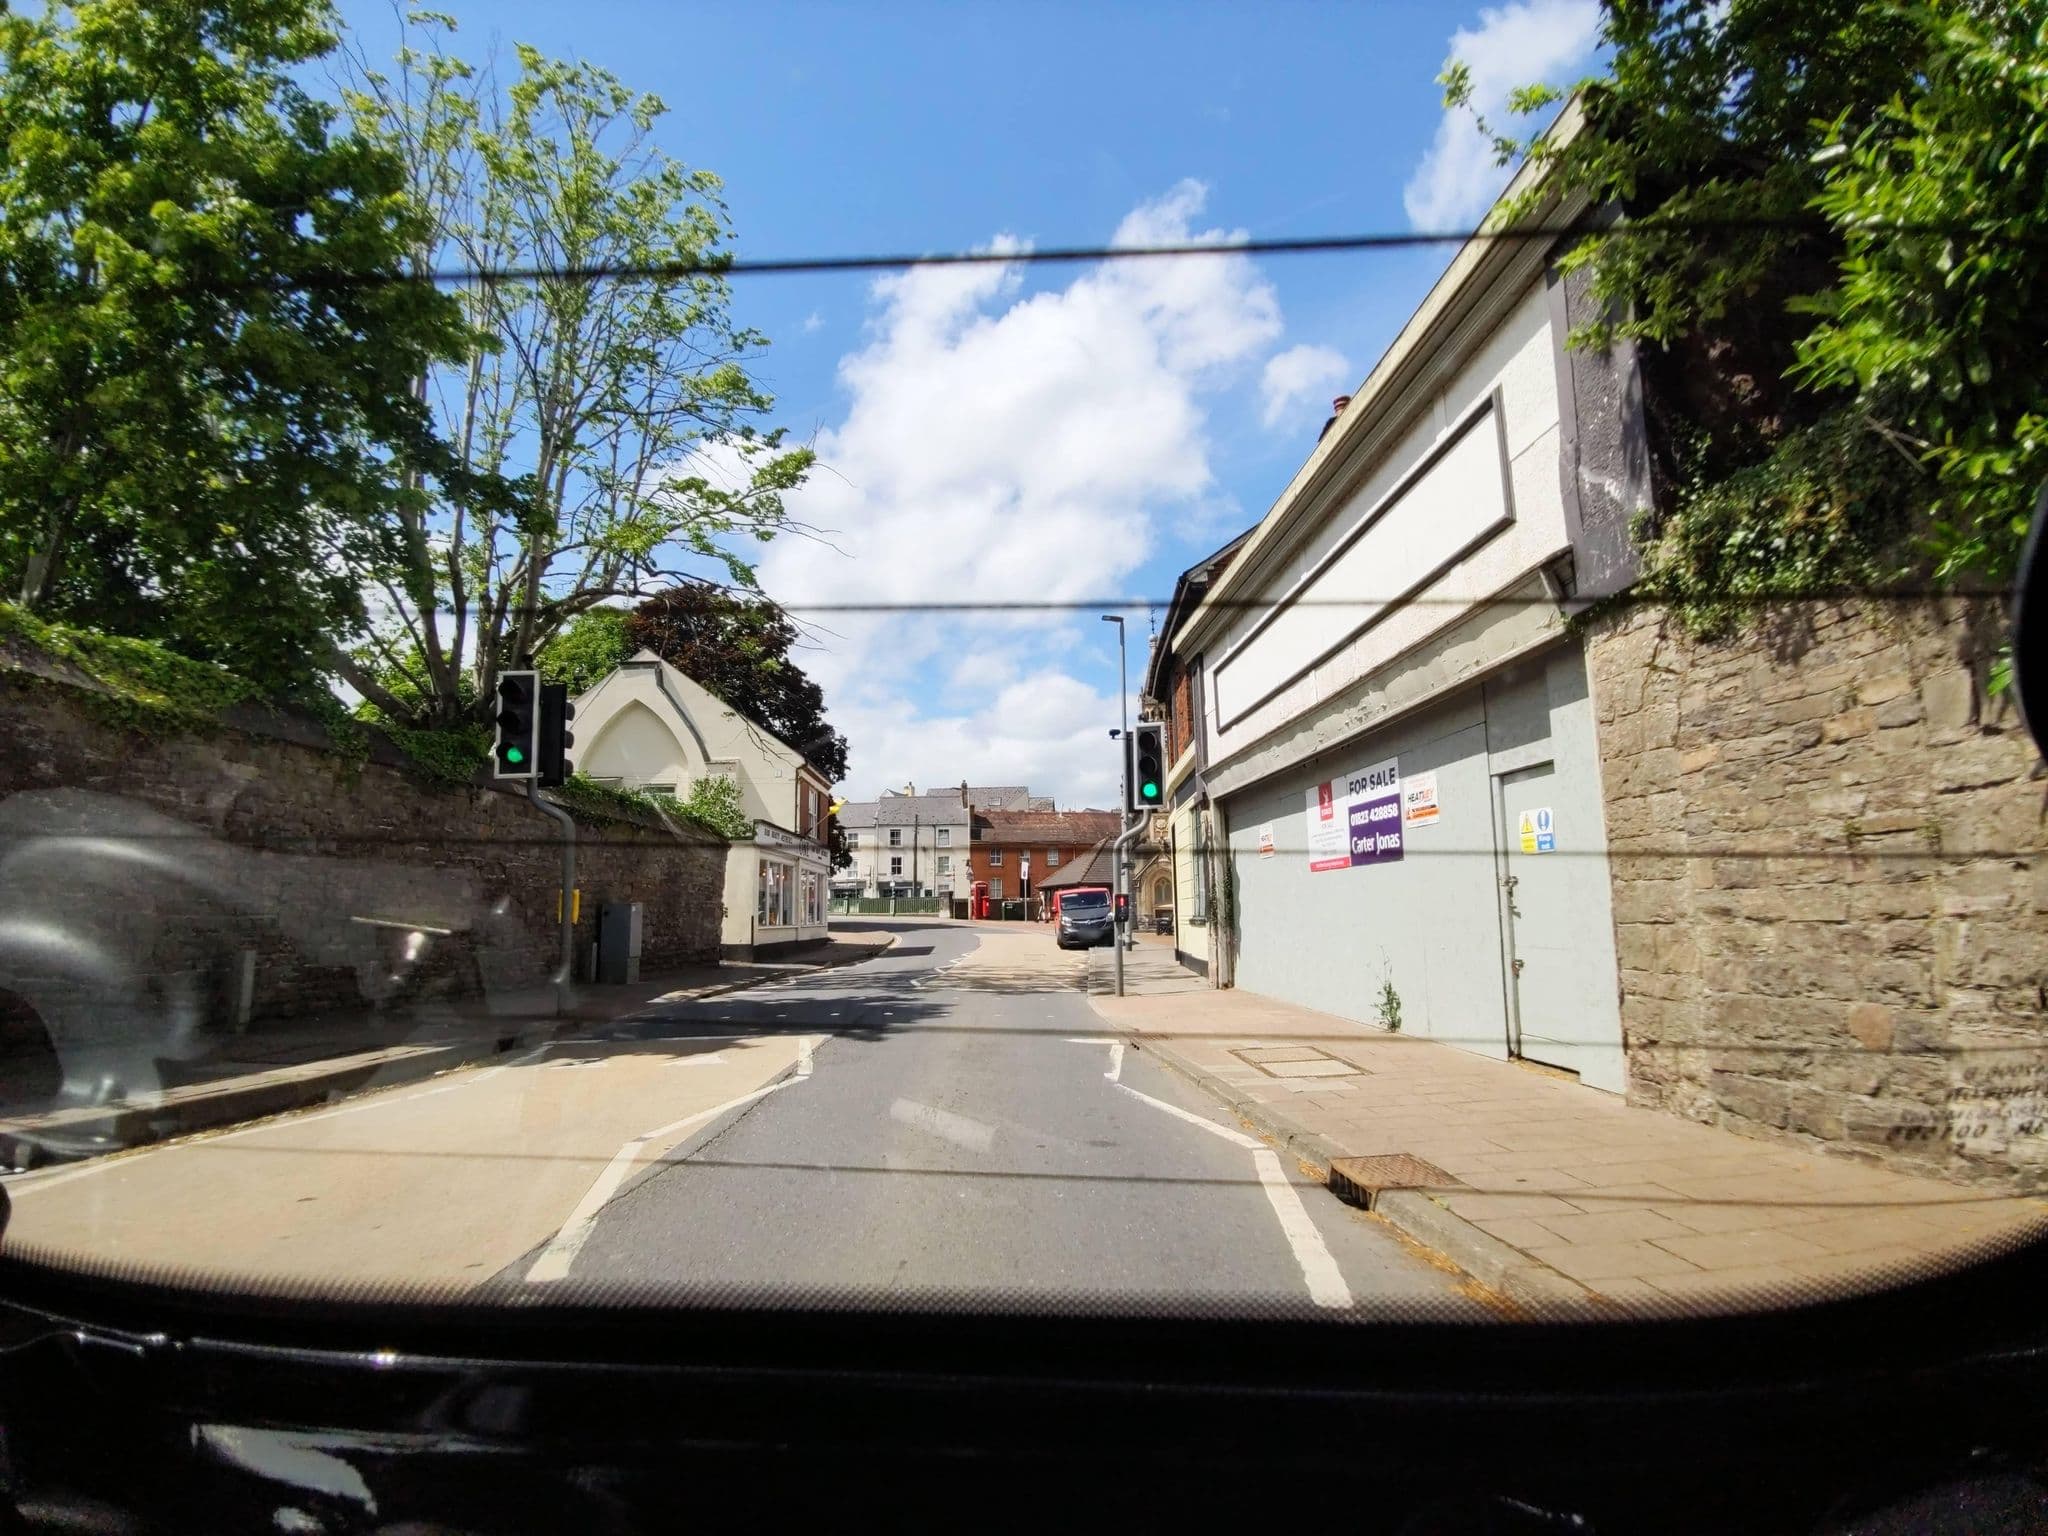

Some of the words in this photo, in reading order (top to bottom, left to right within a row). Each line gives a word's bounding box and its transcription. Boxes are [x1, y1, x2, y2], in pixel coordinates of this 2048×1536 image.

[1349, 777, 1367, 796] FOR
[1369, 767, 1396, 790] SALE
[1350, 810, 1369, 827] 01823
[1352, 836, 1375, 855] Carter
[1376, 832, 1400, 855] Jonas
